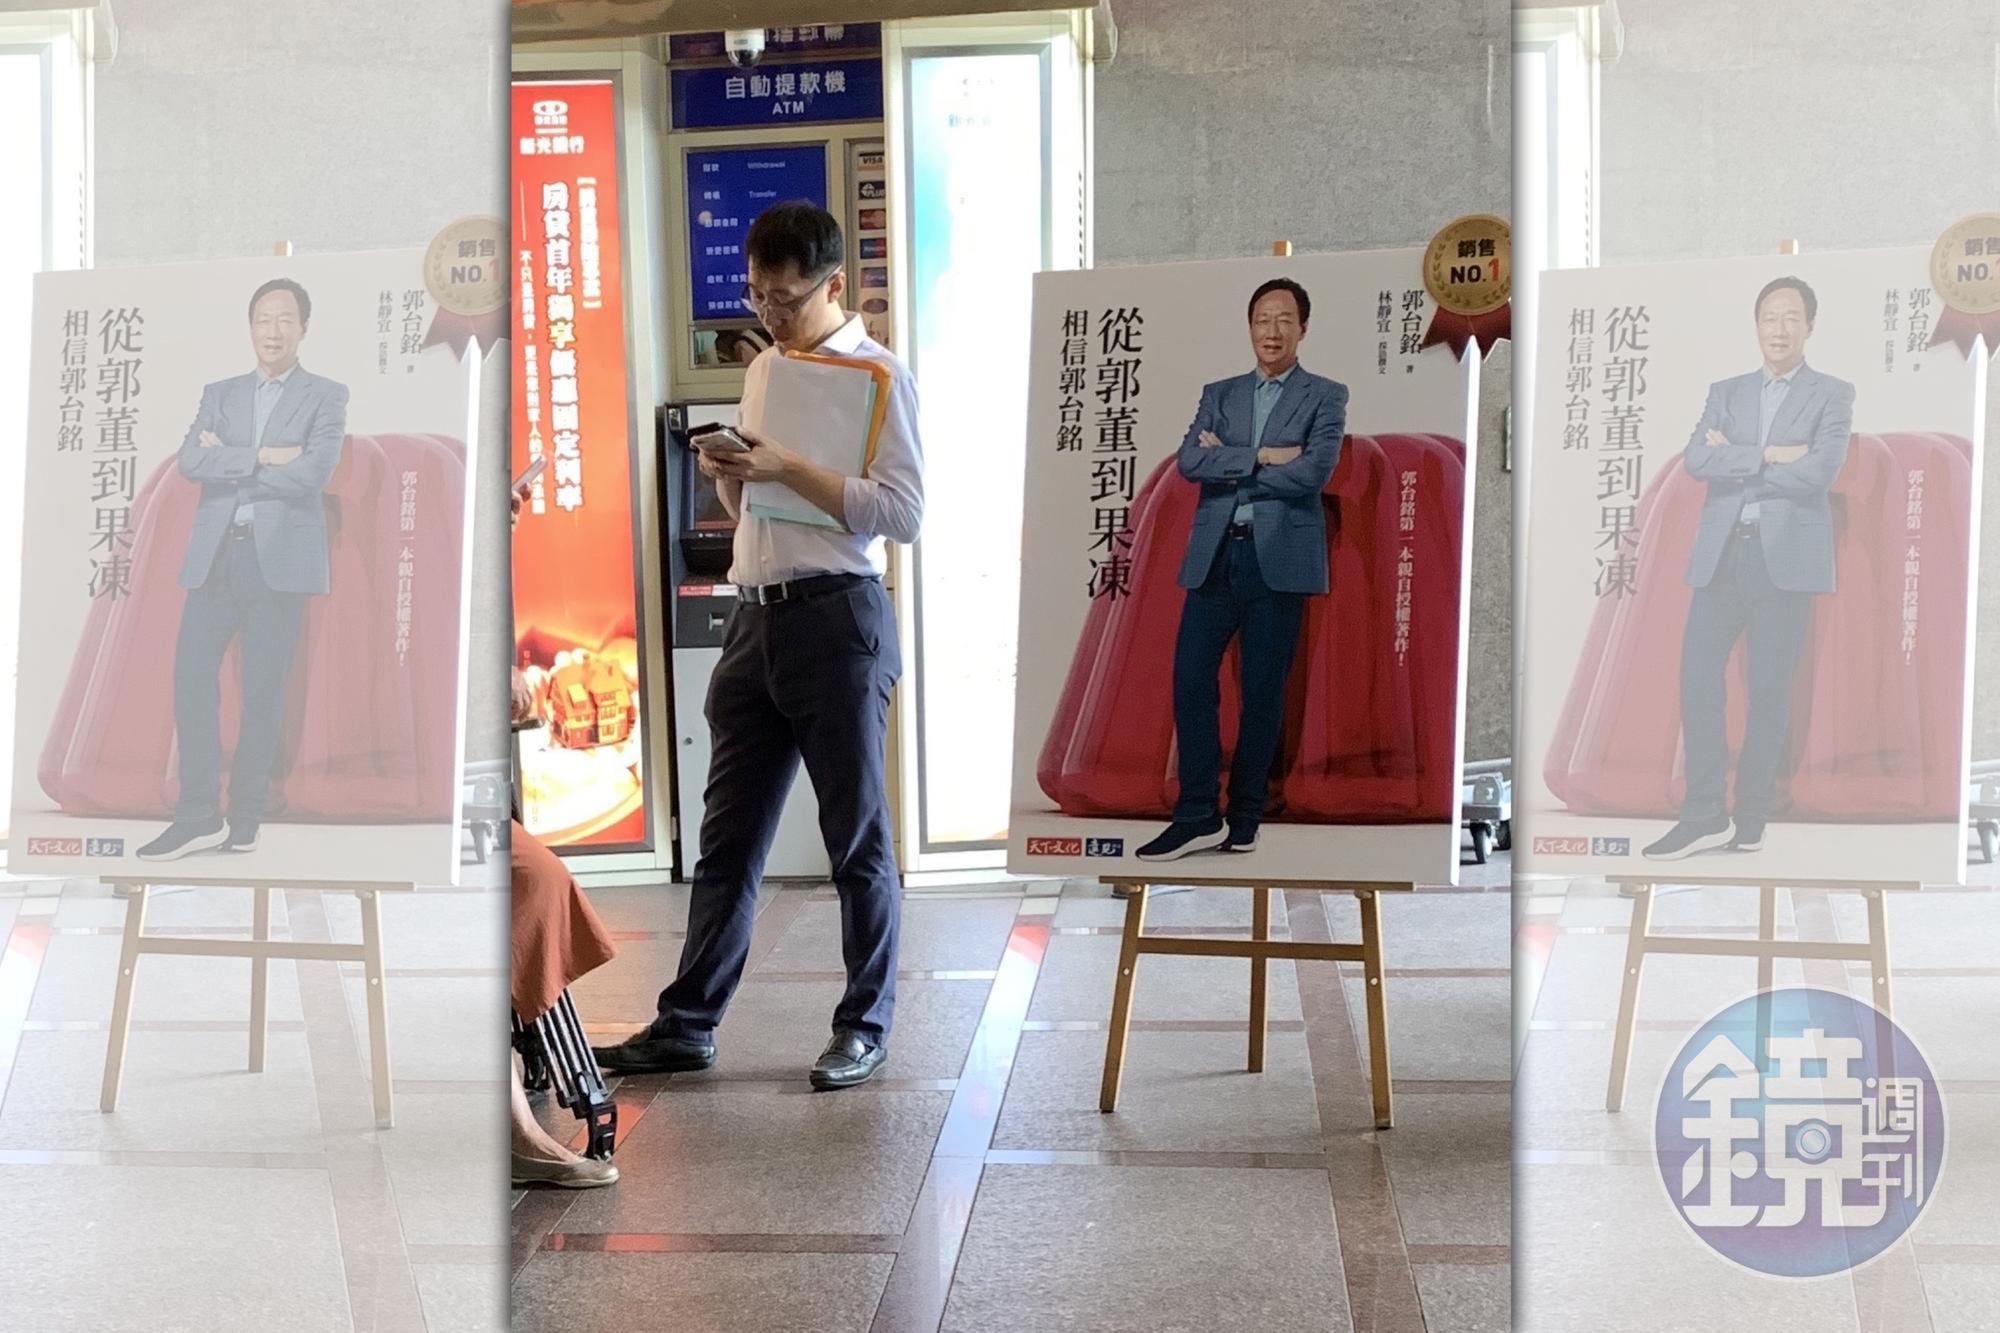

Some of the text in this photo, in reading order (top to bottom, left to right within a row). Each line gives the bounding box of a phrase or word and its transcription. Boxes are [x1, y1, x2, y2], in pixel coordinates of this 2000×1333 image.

[725, 71, 846, 99] 自動提款機
[772, 102, 805, 115] ATM
[862, 156, 884, 165] VISA
[458, 239, 496, 257] 銷售
[1457, 239, 1496, 257] 銷售
[1964, 237, 2000, 256] 銷售
[1450, 258, 1500, 284] NO.1
[1957, 257, 2000, 282] NO.
[401, 290, 425, 354] 郭台銘
[1377, 290, 1393, 333] 林靜宜
[1400, 290, 1424, 354] 郭台銘
[1906, 288, 1931, 352] 郭台銘
[57, 309, 89, 452] 相信郭台銘
[1057, 309, 1088, 452] 相信郭台銘
[1562, 307, 1595, 451] 相信郭台銘
[87, 307, 144, 601] 從郭董到果凍
[1087, 307, 1144, 601] 從郭董到果凍
[1592, 306, 1650, 598] 從郭董到果凍
[1029, 840, 1080, 854] 天下文化
